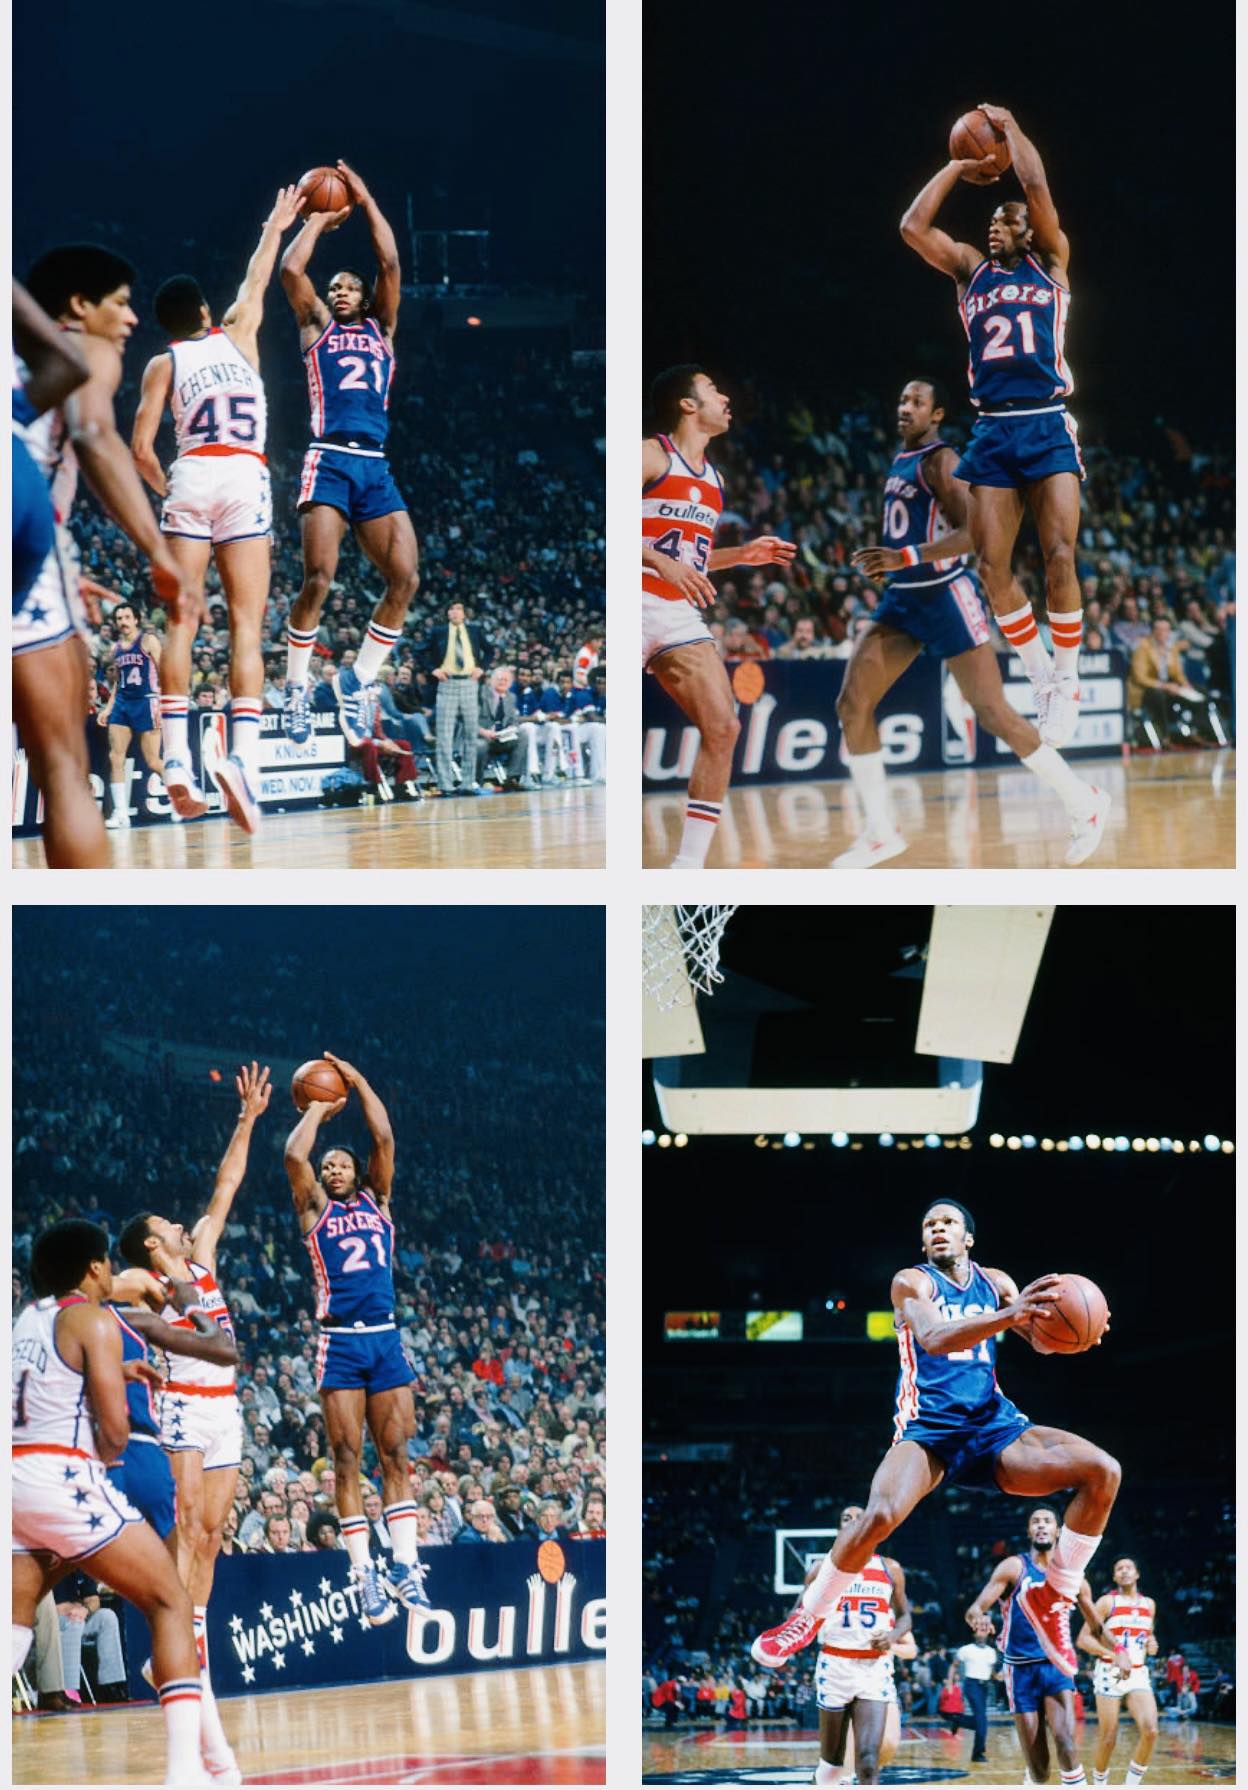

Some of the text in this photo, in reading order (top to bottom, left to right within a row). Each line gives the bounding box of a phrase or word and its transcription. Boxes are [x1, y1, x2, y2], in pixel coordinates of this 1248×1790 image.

[981, 310, 1037, 361] 21
[337, 355, 384, 394] 21
[186, 395, 258, 443] 45
[652, 528, 711, 573] 45
[120, 666, 142, 688] 14
[338, 1234, 387, 1273] 21
[841, 1601, 878, 1629] 15
